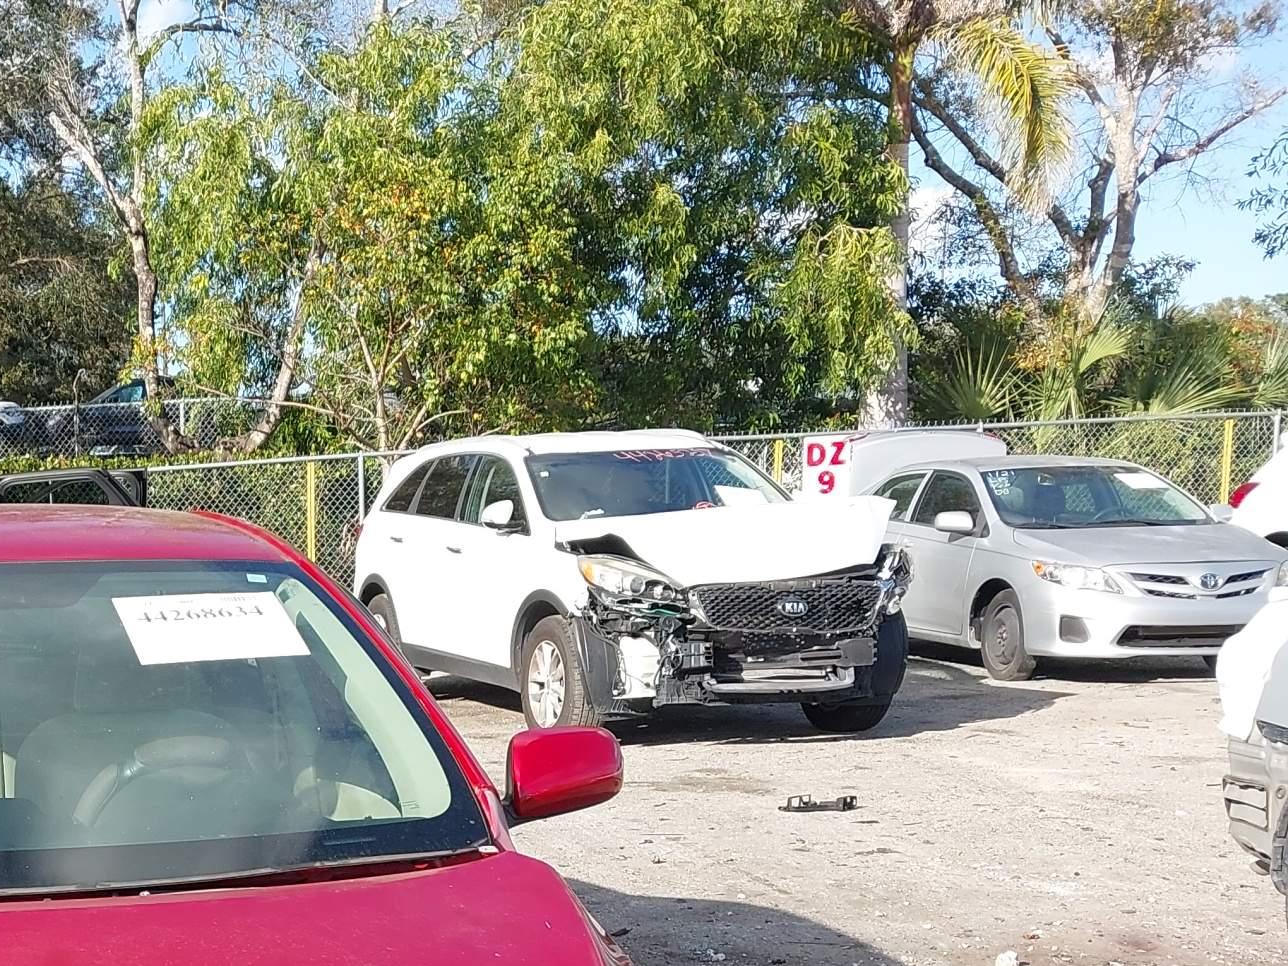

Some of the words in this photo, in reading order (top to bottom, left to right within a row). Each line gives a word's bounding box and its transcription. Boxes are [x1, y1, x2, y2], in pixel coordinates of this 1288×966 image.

[807, 441, 846, 466] DZ
[818, 470, 835, 494] 9
[136, 605, 264, 623] 44268634
[784, 602, 805, 613] KIA
